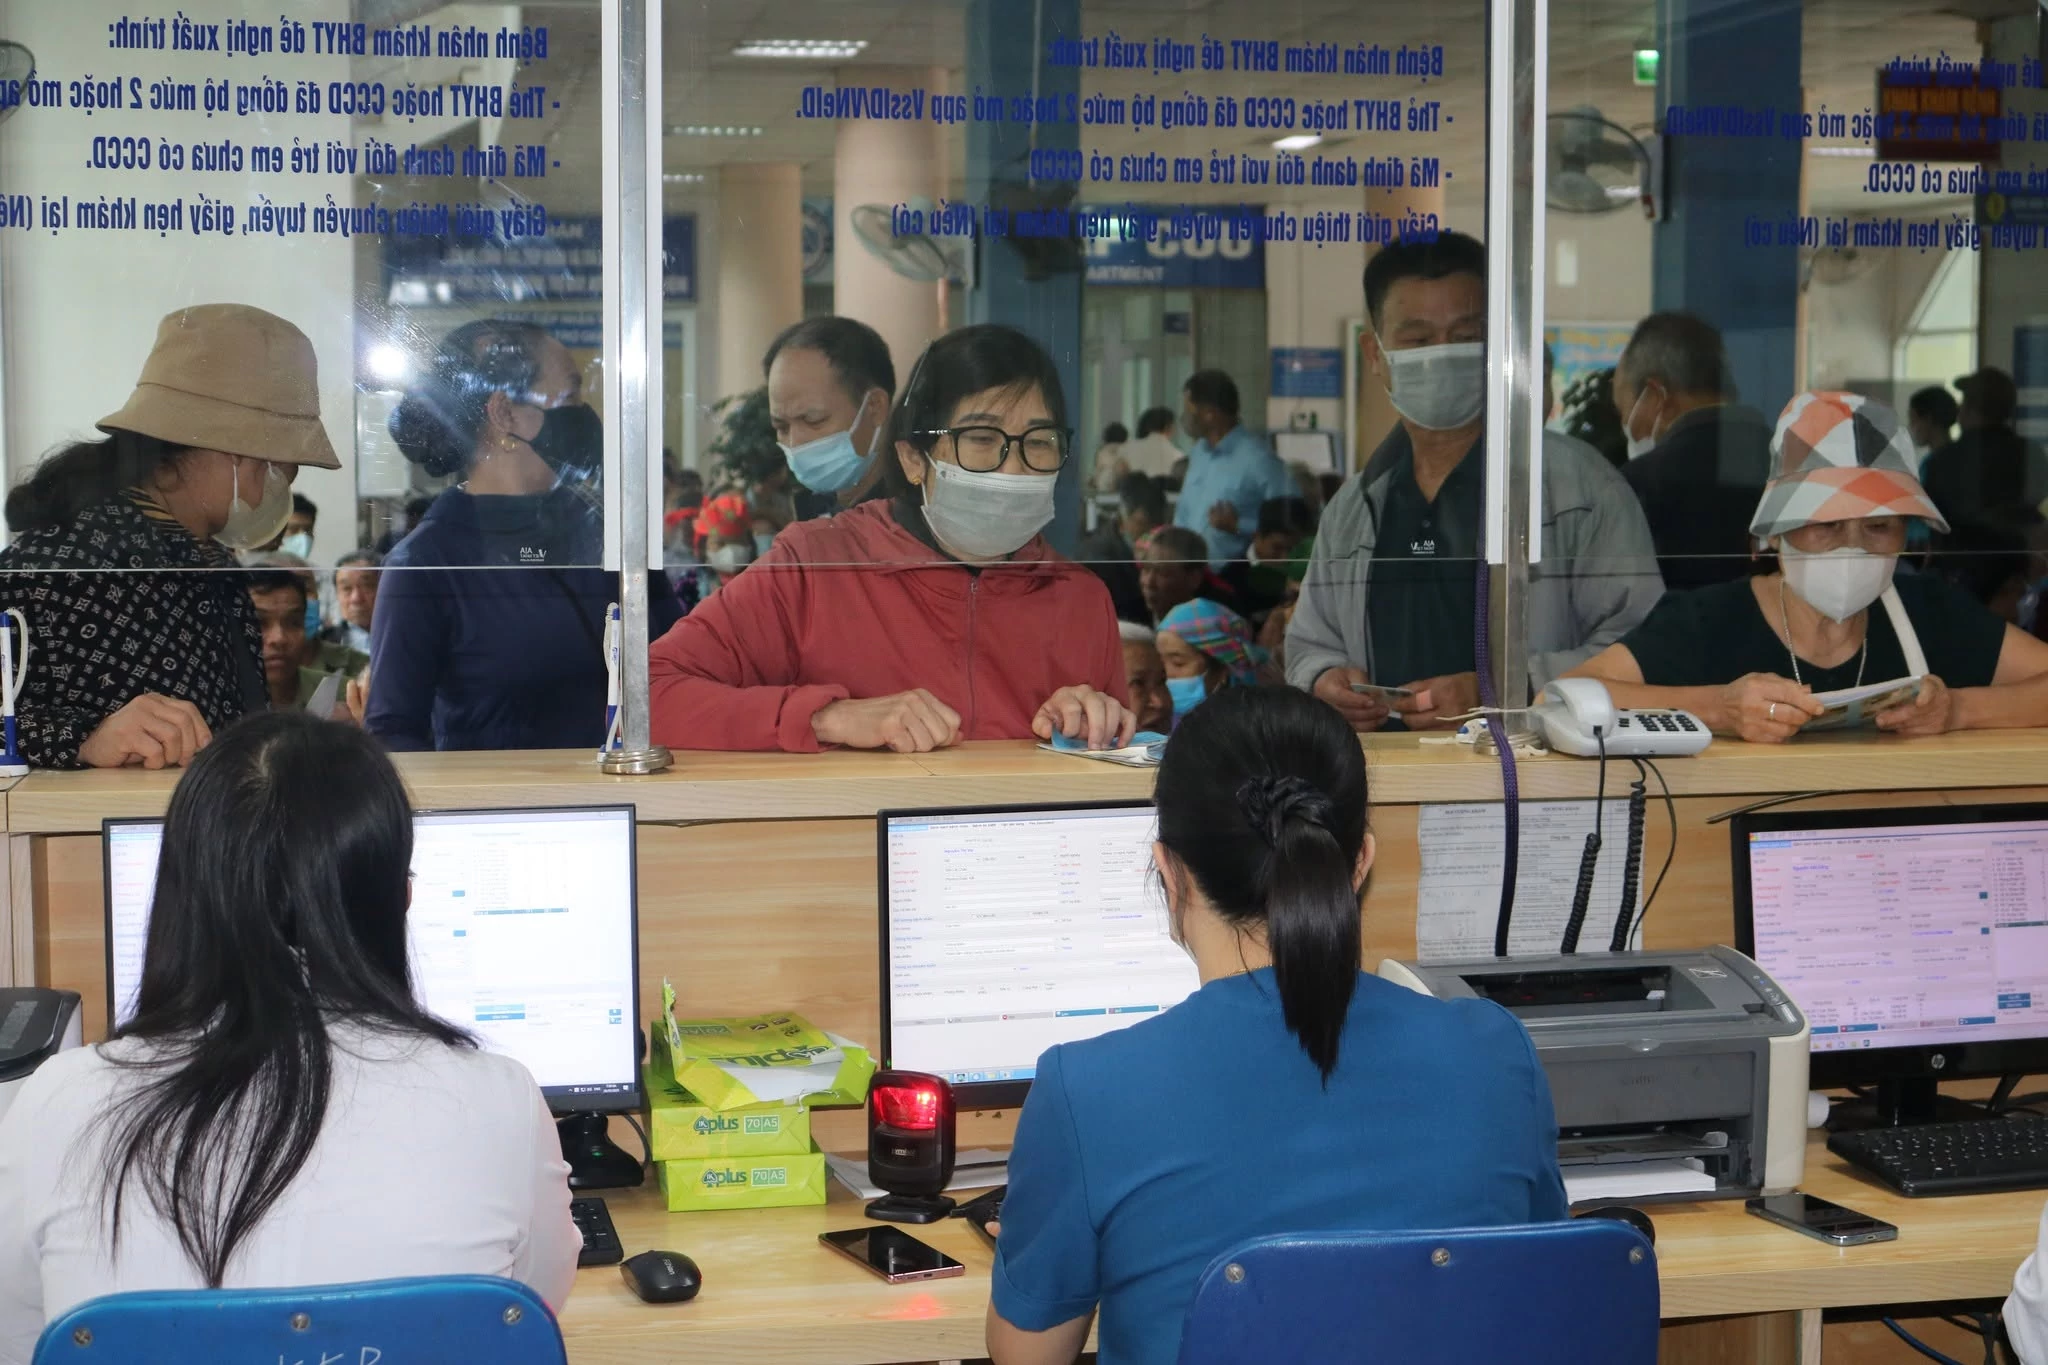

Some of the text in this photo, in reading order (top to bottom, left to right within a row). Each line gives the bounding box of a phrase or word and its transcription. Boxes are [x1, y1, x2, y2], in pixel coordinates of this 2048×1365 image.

[708, 1114, 739, 1135] plus
[747, 1118, 760, 1129] 70
[764, 1117, 778, 1127] A5
[716, 1167, 748, 1188] plus
[754, 1171, 767, 1181] 70
[771, 1170, 785, 1180] A5
